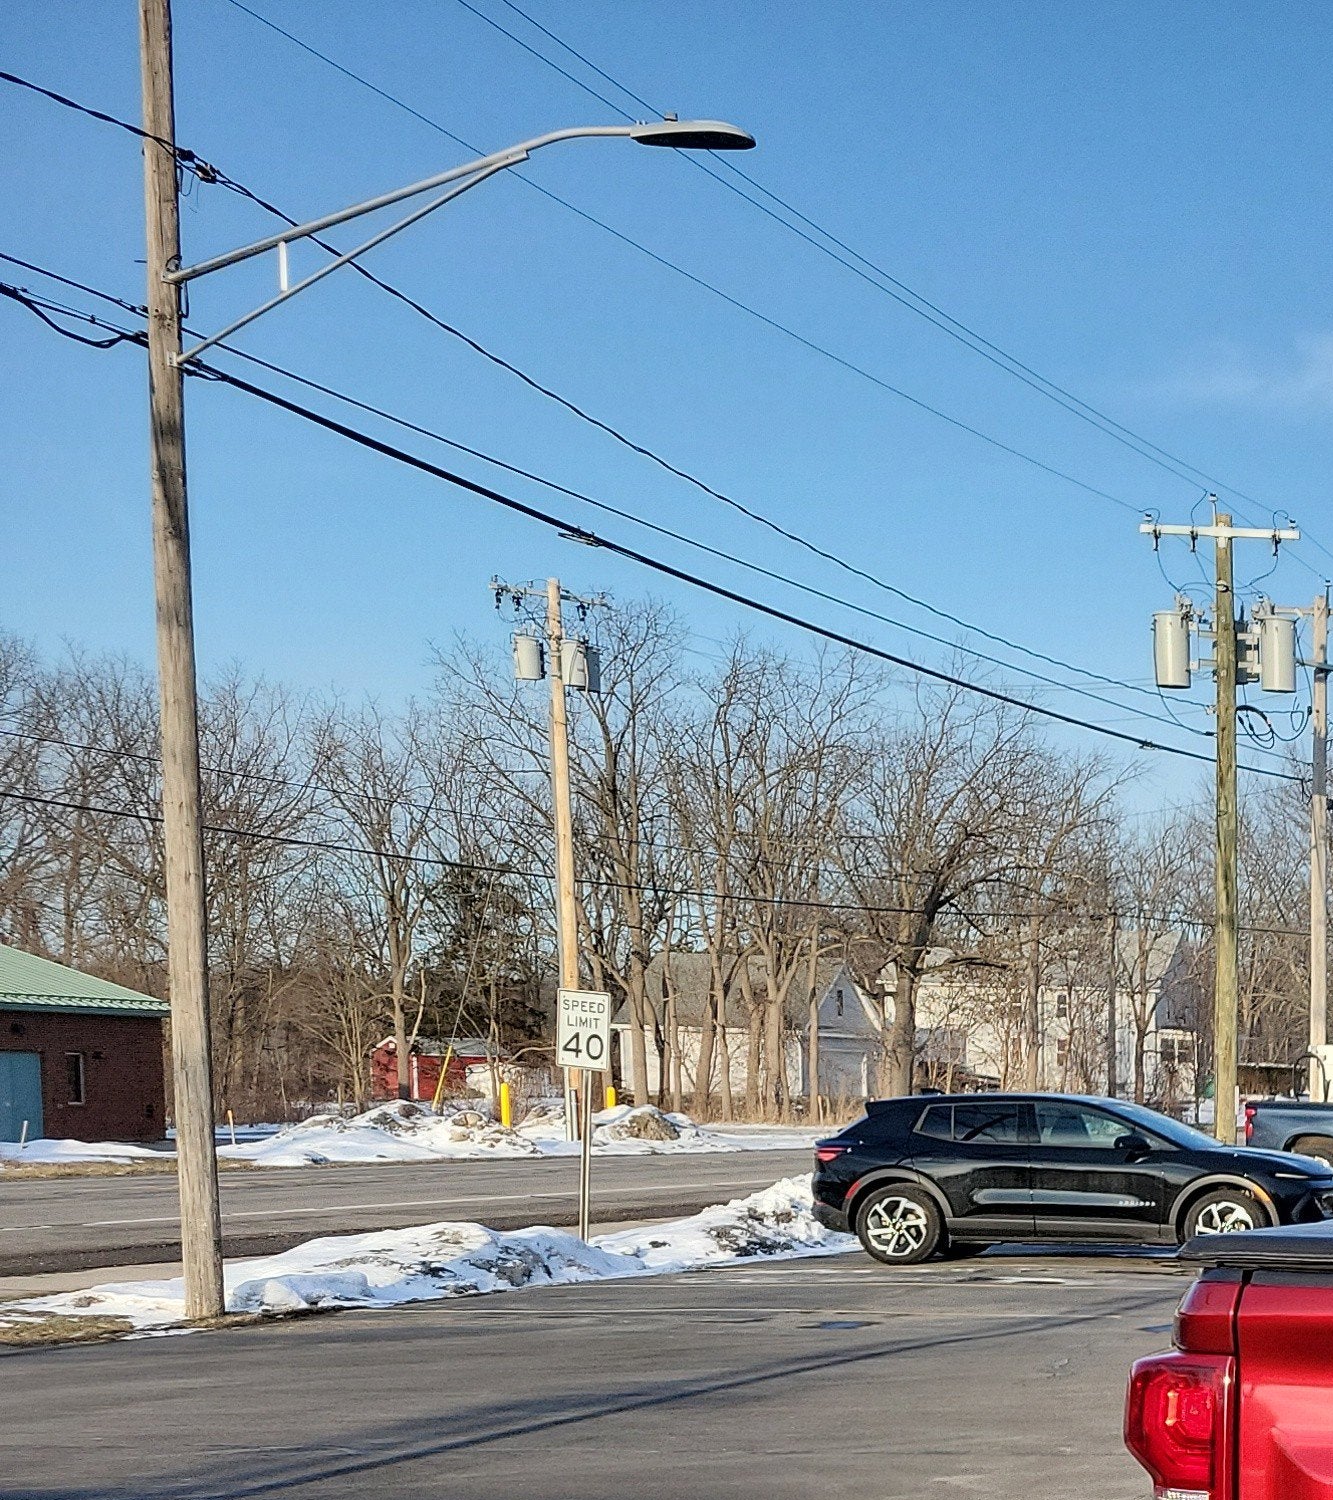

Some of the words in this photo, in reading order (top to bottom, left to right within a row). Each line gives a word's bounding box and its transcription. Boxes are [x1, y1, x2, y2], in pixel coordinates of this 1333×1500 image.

[562, 999, 606, 1014] SPEED
[567, 1015, 601, 1029] LIMIT
[562, 1032, 604, 1060] 40
